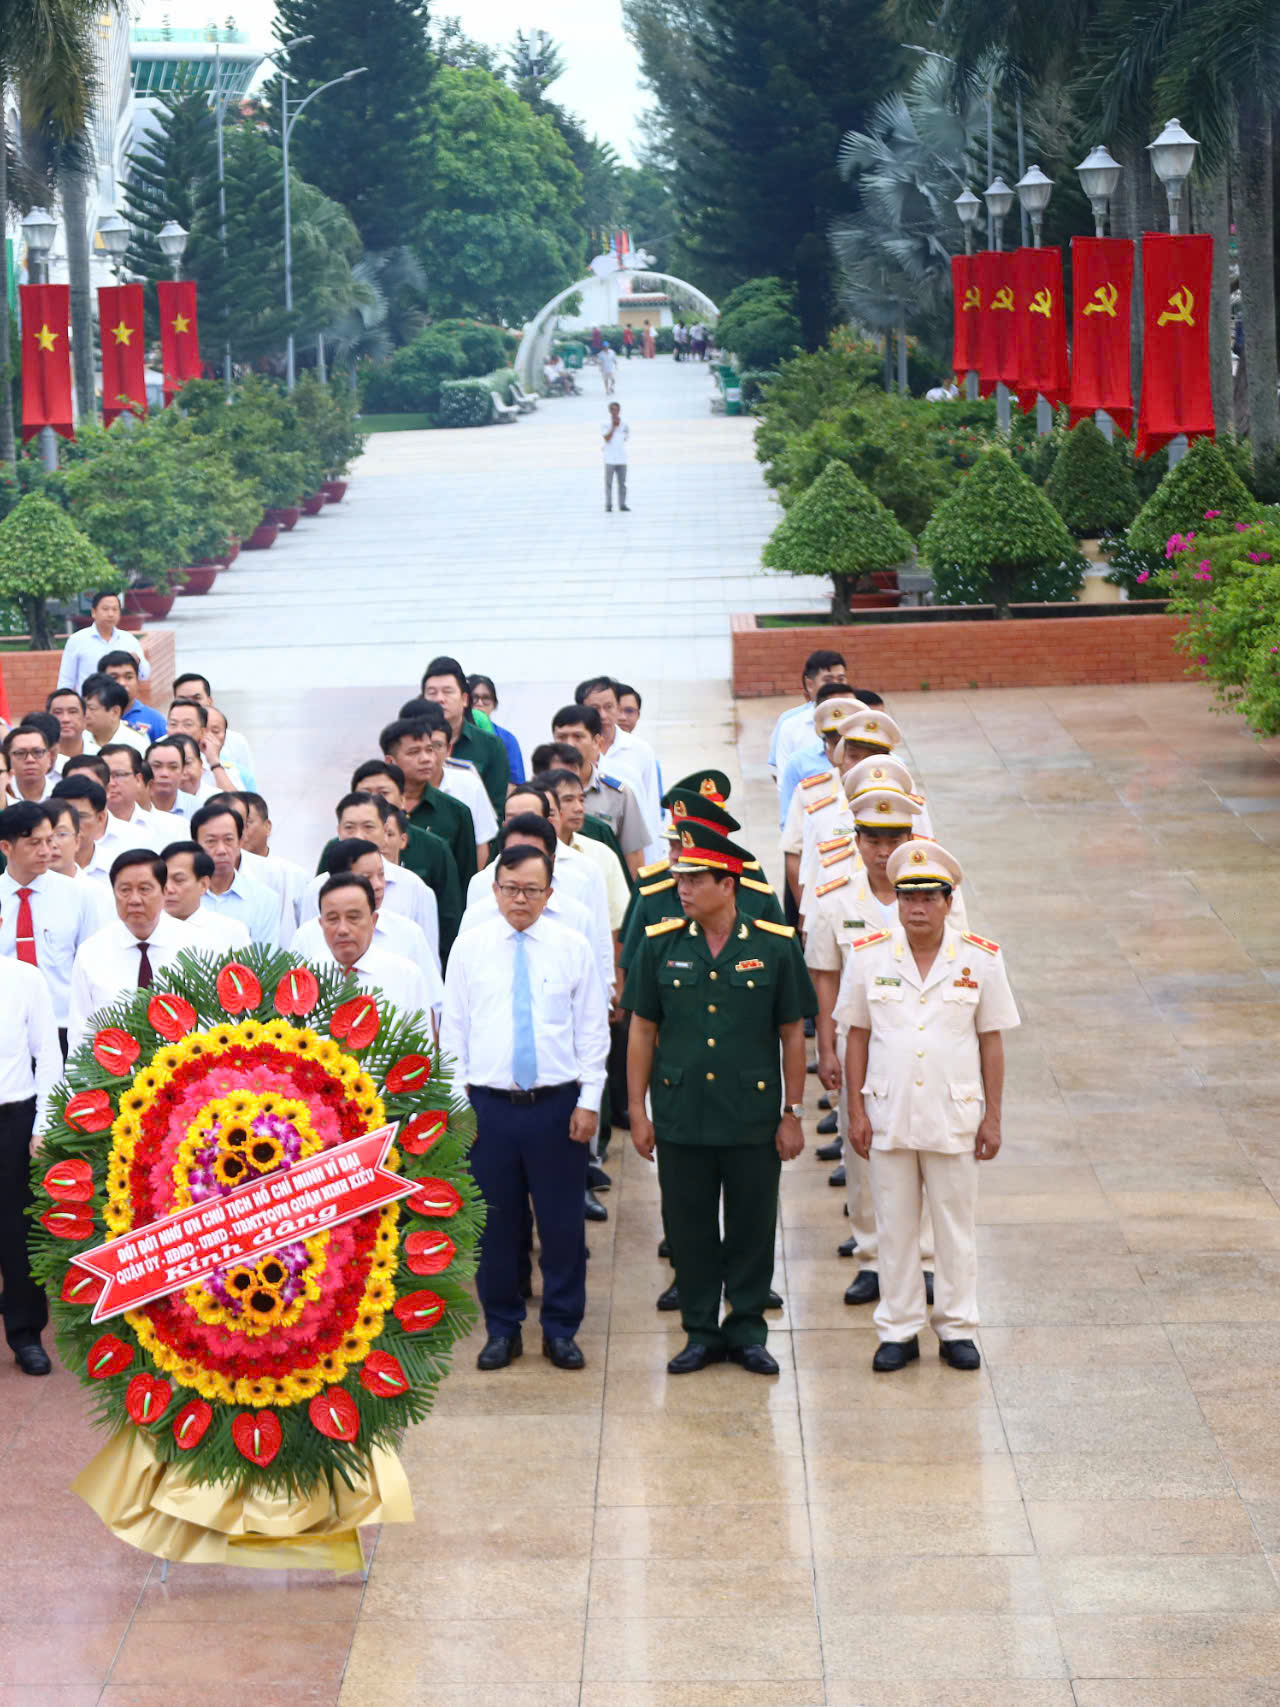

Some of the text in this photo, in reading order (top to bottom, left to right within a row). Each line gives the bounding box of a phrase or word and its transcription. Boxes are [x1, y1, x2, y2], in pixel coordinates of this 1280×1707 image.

[115, 1261, 146, 1285] QUẬN
[145, 1253, 161, 1273] ỦY
[164, 1242, 195, 1265] HĐND
[198, 1228, 229, 1249] UBND
[232, 1202, 291, 1236] UBMTTQVN
[289, 1189, 322, 1213] QUẬN
[320, 1178, 350, 1201] NINH
[347, 1165, 376, 1190] KIỀU
[157, 1221, 183, 1247] NHỚ
[183, 1217, 202, 1235] ƠN
[202, 1203, 226, 1228] CHỦ
[225, 1194, 254, 1219] TỊCH
[252, 1183, 270, 1207] HỒ
[270, 1175, 293, 1199] CHÍ
[291, 1166, 326, 1191] MINH
[325, 1157, 340, 1177] VĨ
[338, 1151, 361, 1171] ĐẠI
[165, 1203, 338, 1283] Kính dâng
